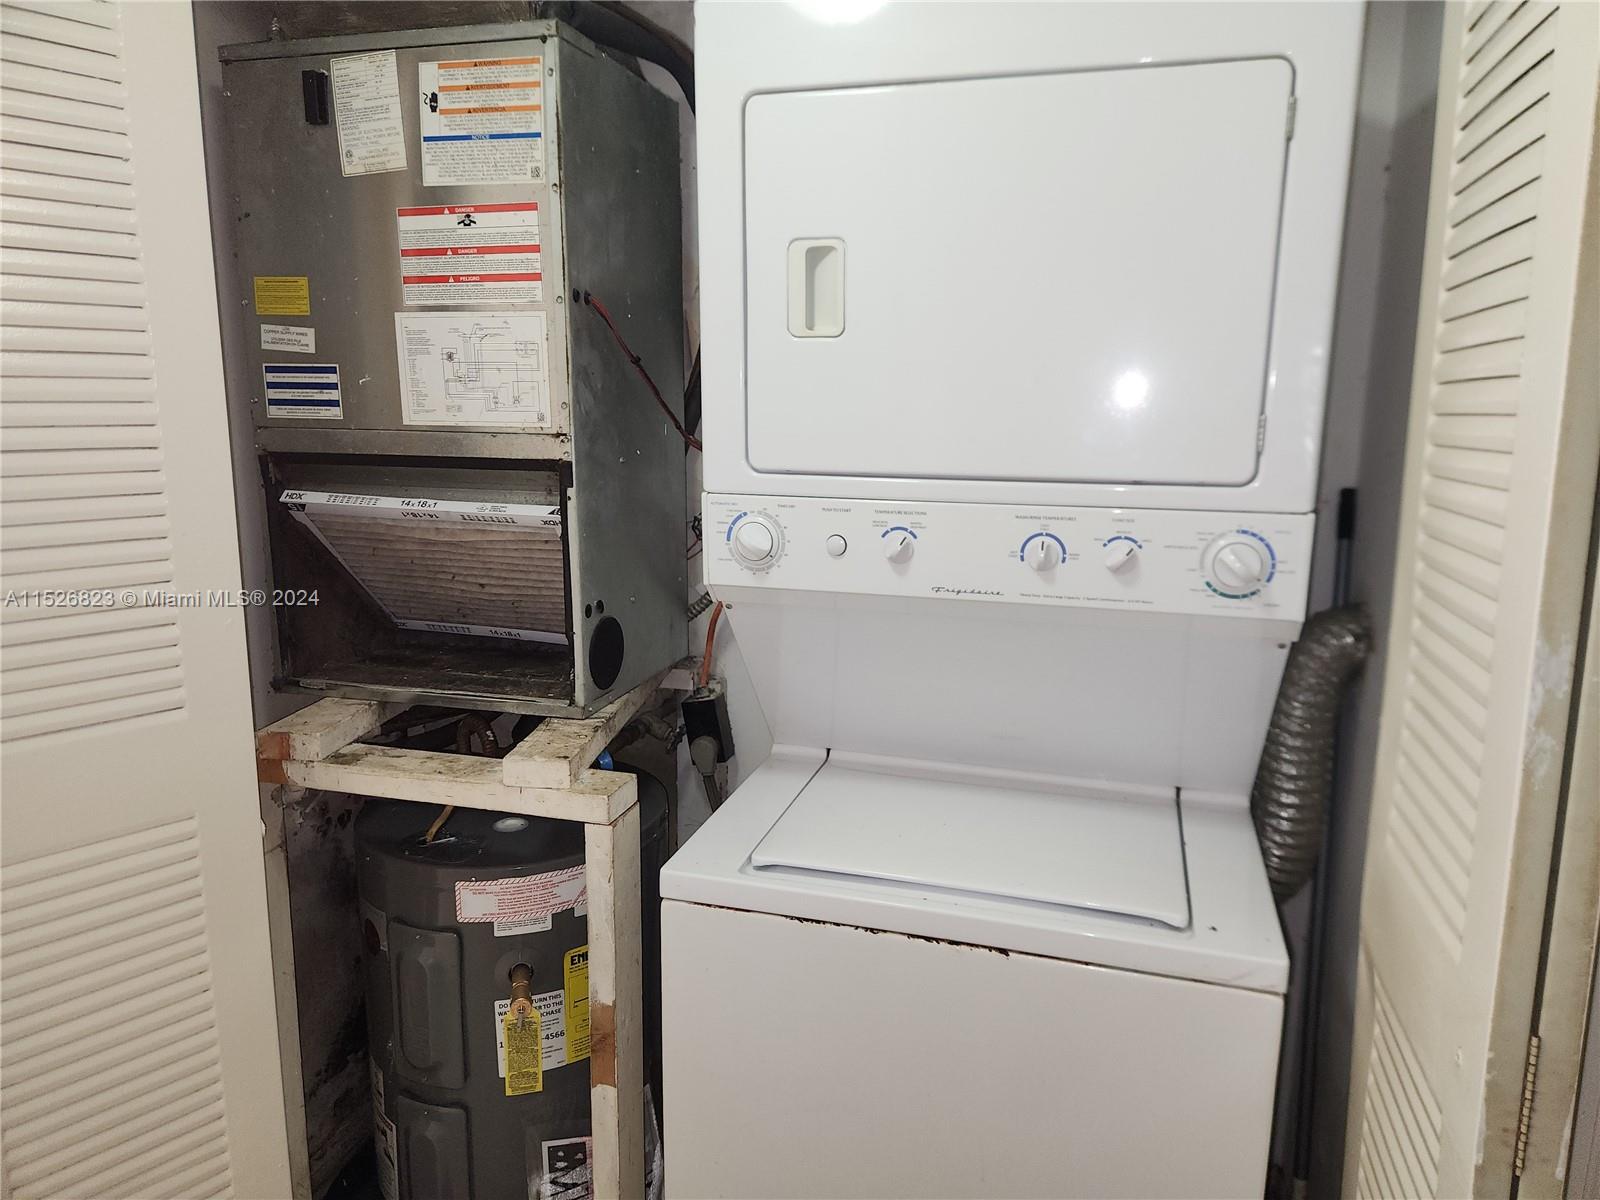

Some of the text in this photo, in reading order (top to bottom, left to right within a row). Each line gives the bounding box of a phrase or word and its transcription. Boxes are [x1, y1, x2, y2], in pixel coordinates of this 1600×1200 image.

[285, 491, 304, 500] HDX
[931, 586, 1004, 597] Frigidaire
[532, 996, 548, 1004] TURN
[548, 993, 562, 1001] THIS
[551, 1000, 564, 1008] THE
[499, 1030, 565, 1049] 1 -4566
